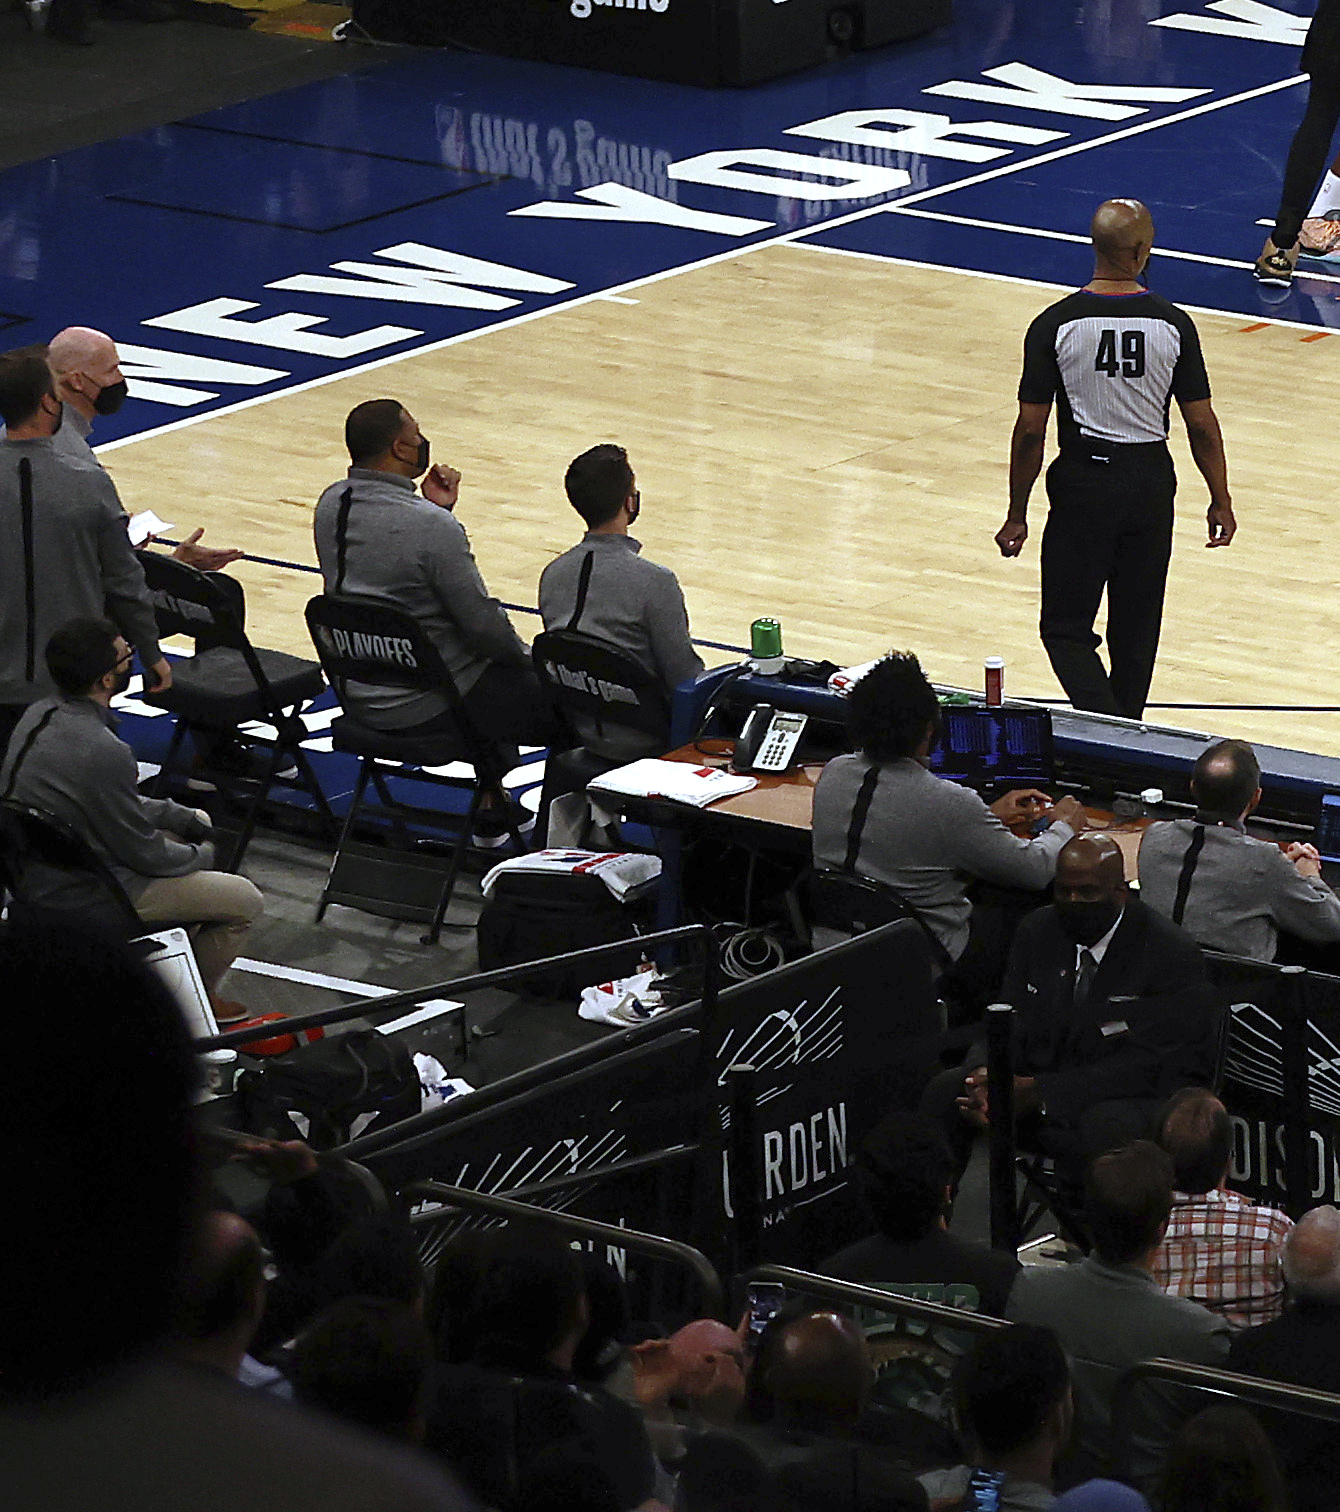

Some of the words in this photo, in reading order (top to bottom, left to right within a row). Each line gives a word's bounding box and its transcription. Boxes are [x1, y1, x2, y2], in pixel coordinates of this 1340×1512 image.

[97, 242, 576, 409] NEW
[504, 61, 1213, 238] YORK
[1094, 328, 1147, 379] 49
[332, 627, 419, 669] PLAYOFFS
[742, 1102, 848, 1210] RDEN
